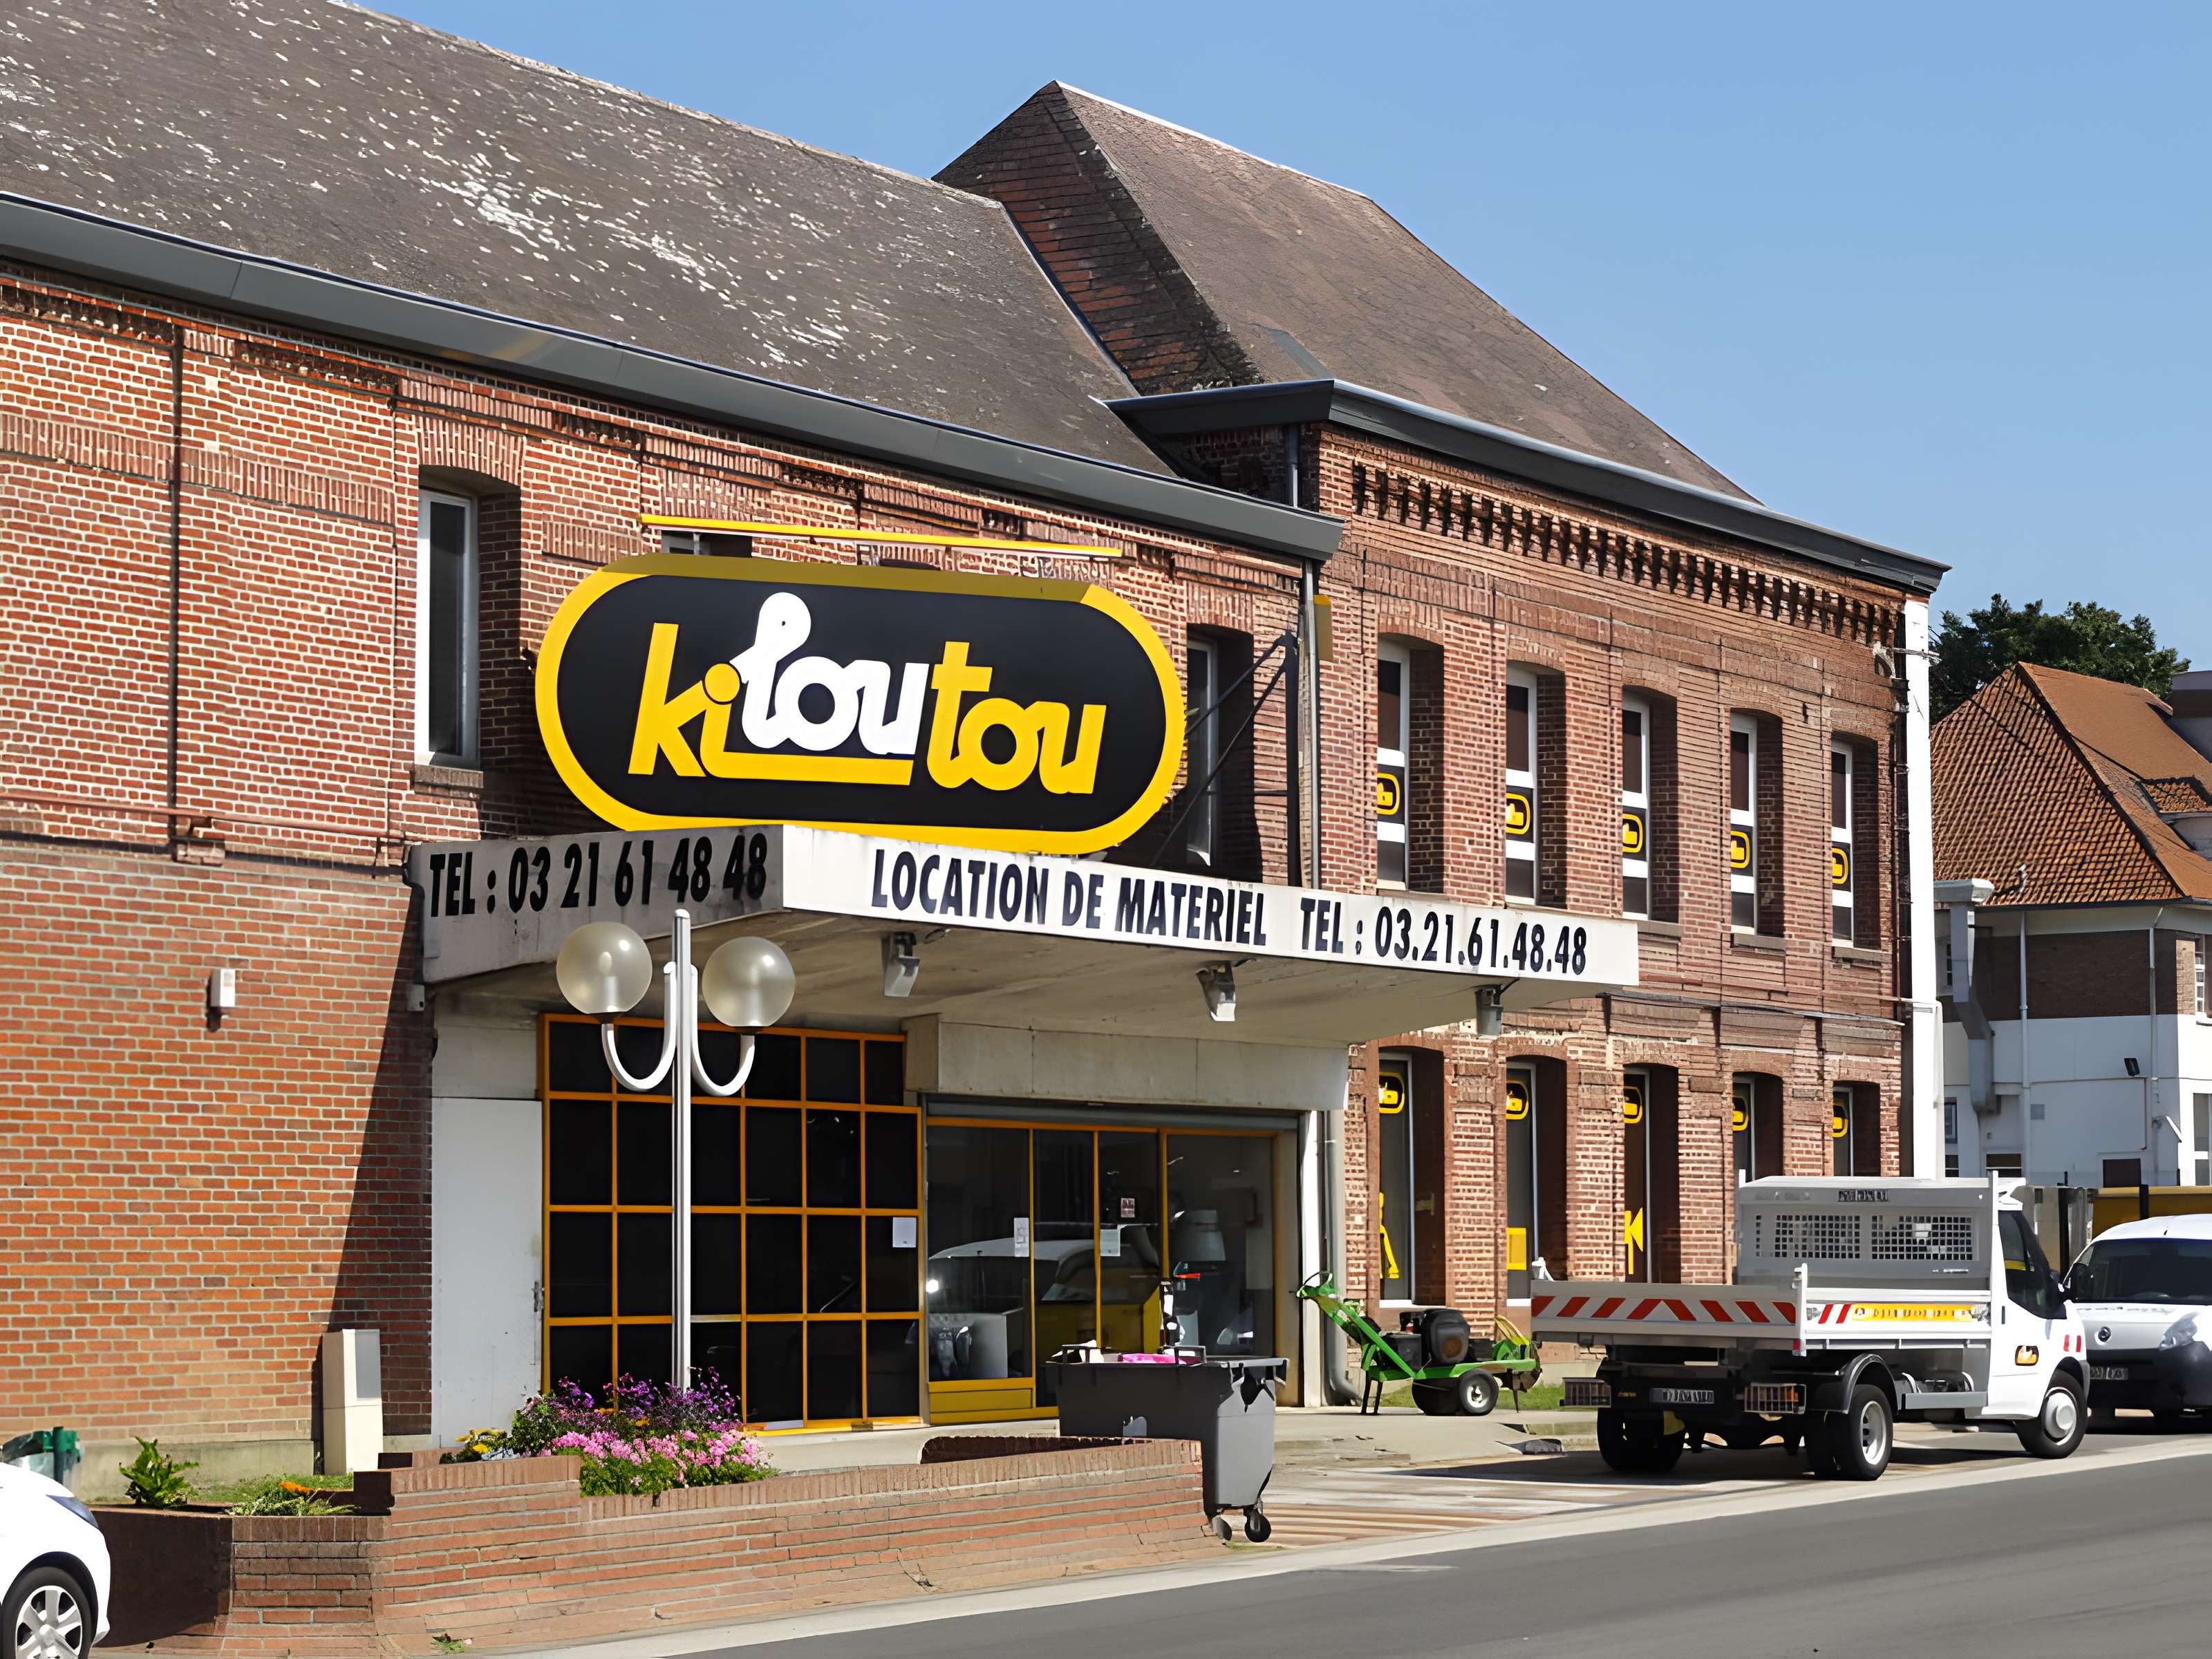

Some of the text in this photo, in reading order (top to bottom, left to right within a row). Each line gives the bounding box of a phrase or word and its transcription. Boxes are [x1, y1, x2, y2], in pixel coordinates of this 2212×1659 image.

[628, 592, 1107, 795] kiloutou
[871, 848, 1049, 925] LOCATION
[1062, 870, 1105, 929] DE
[1115, 877, 1267, 946] MATERIEL
